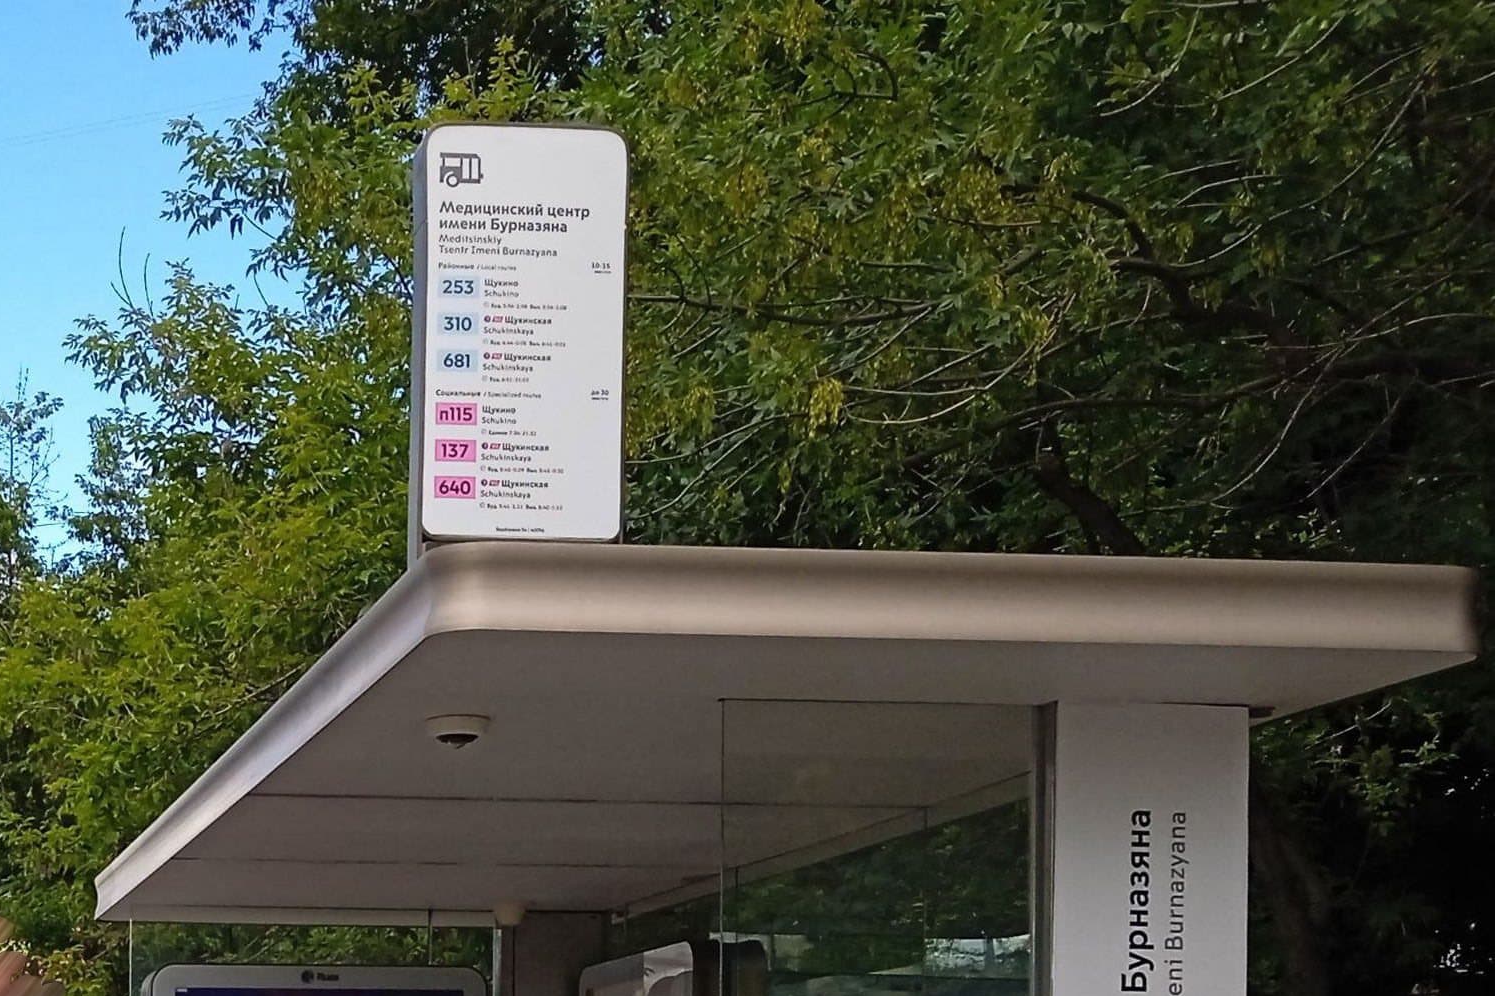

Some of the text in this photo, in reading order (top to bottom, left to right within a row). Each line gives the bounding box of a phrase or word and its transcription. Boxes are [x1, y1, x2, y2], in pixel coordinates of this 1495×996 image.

[439, 201, 590, 220] Медицинский центр
[439, 219, 568, 234] имени Бурназяна
[438, 234, 502, 245] Meditsinskiy
[438, 245, 558, 258] Tsentr Imeni Burnazyana
[442, 279, 474, 295] 253
[484, 278, 519, 288] Щукино
[443, 316, 472, 332] 310
[504, 315, 553, 326] Щукинская
[443, 353, 471, 369] 681
[503, 352, 552, 363] Щукинская
[481, 404, 517, 415] Щукино
[481, 416, 518, 425] Schukino
[440, 443, 469, 459] 137
[502, 442, 550, 453] Щукинская
[480, 453, 532, 463] Schukinskaya
[438, 480, 472, 496] 640
[501, 479, 549, 490] Щукинская
[480, 489, 531, 500] Schukinskaya
[1164, 811, 1191, 951] Burnazyana
[1120, 808, 1155, 993] Бурназяна
